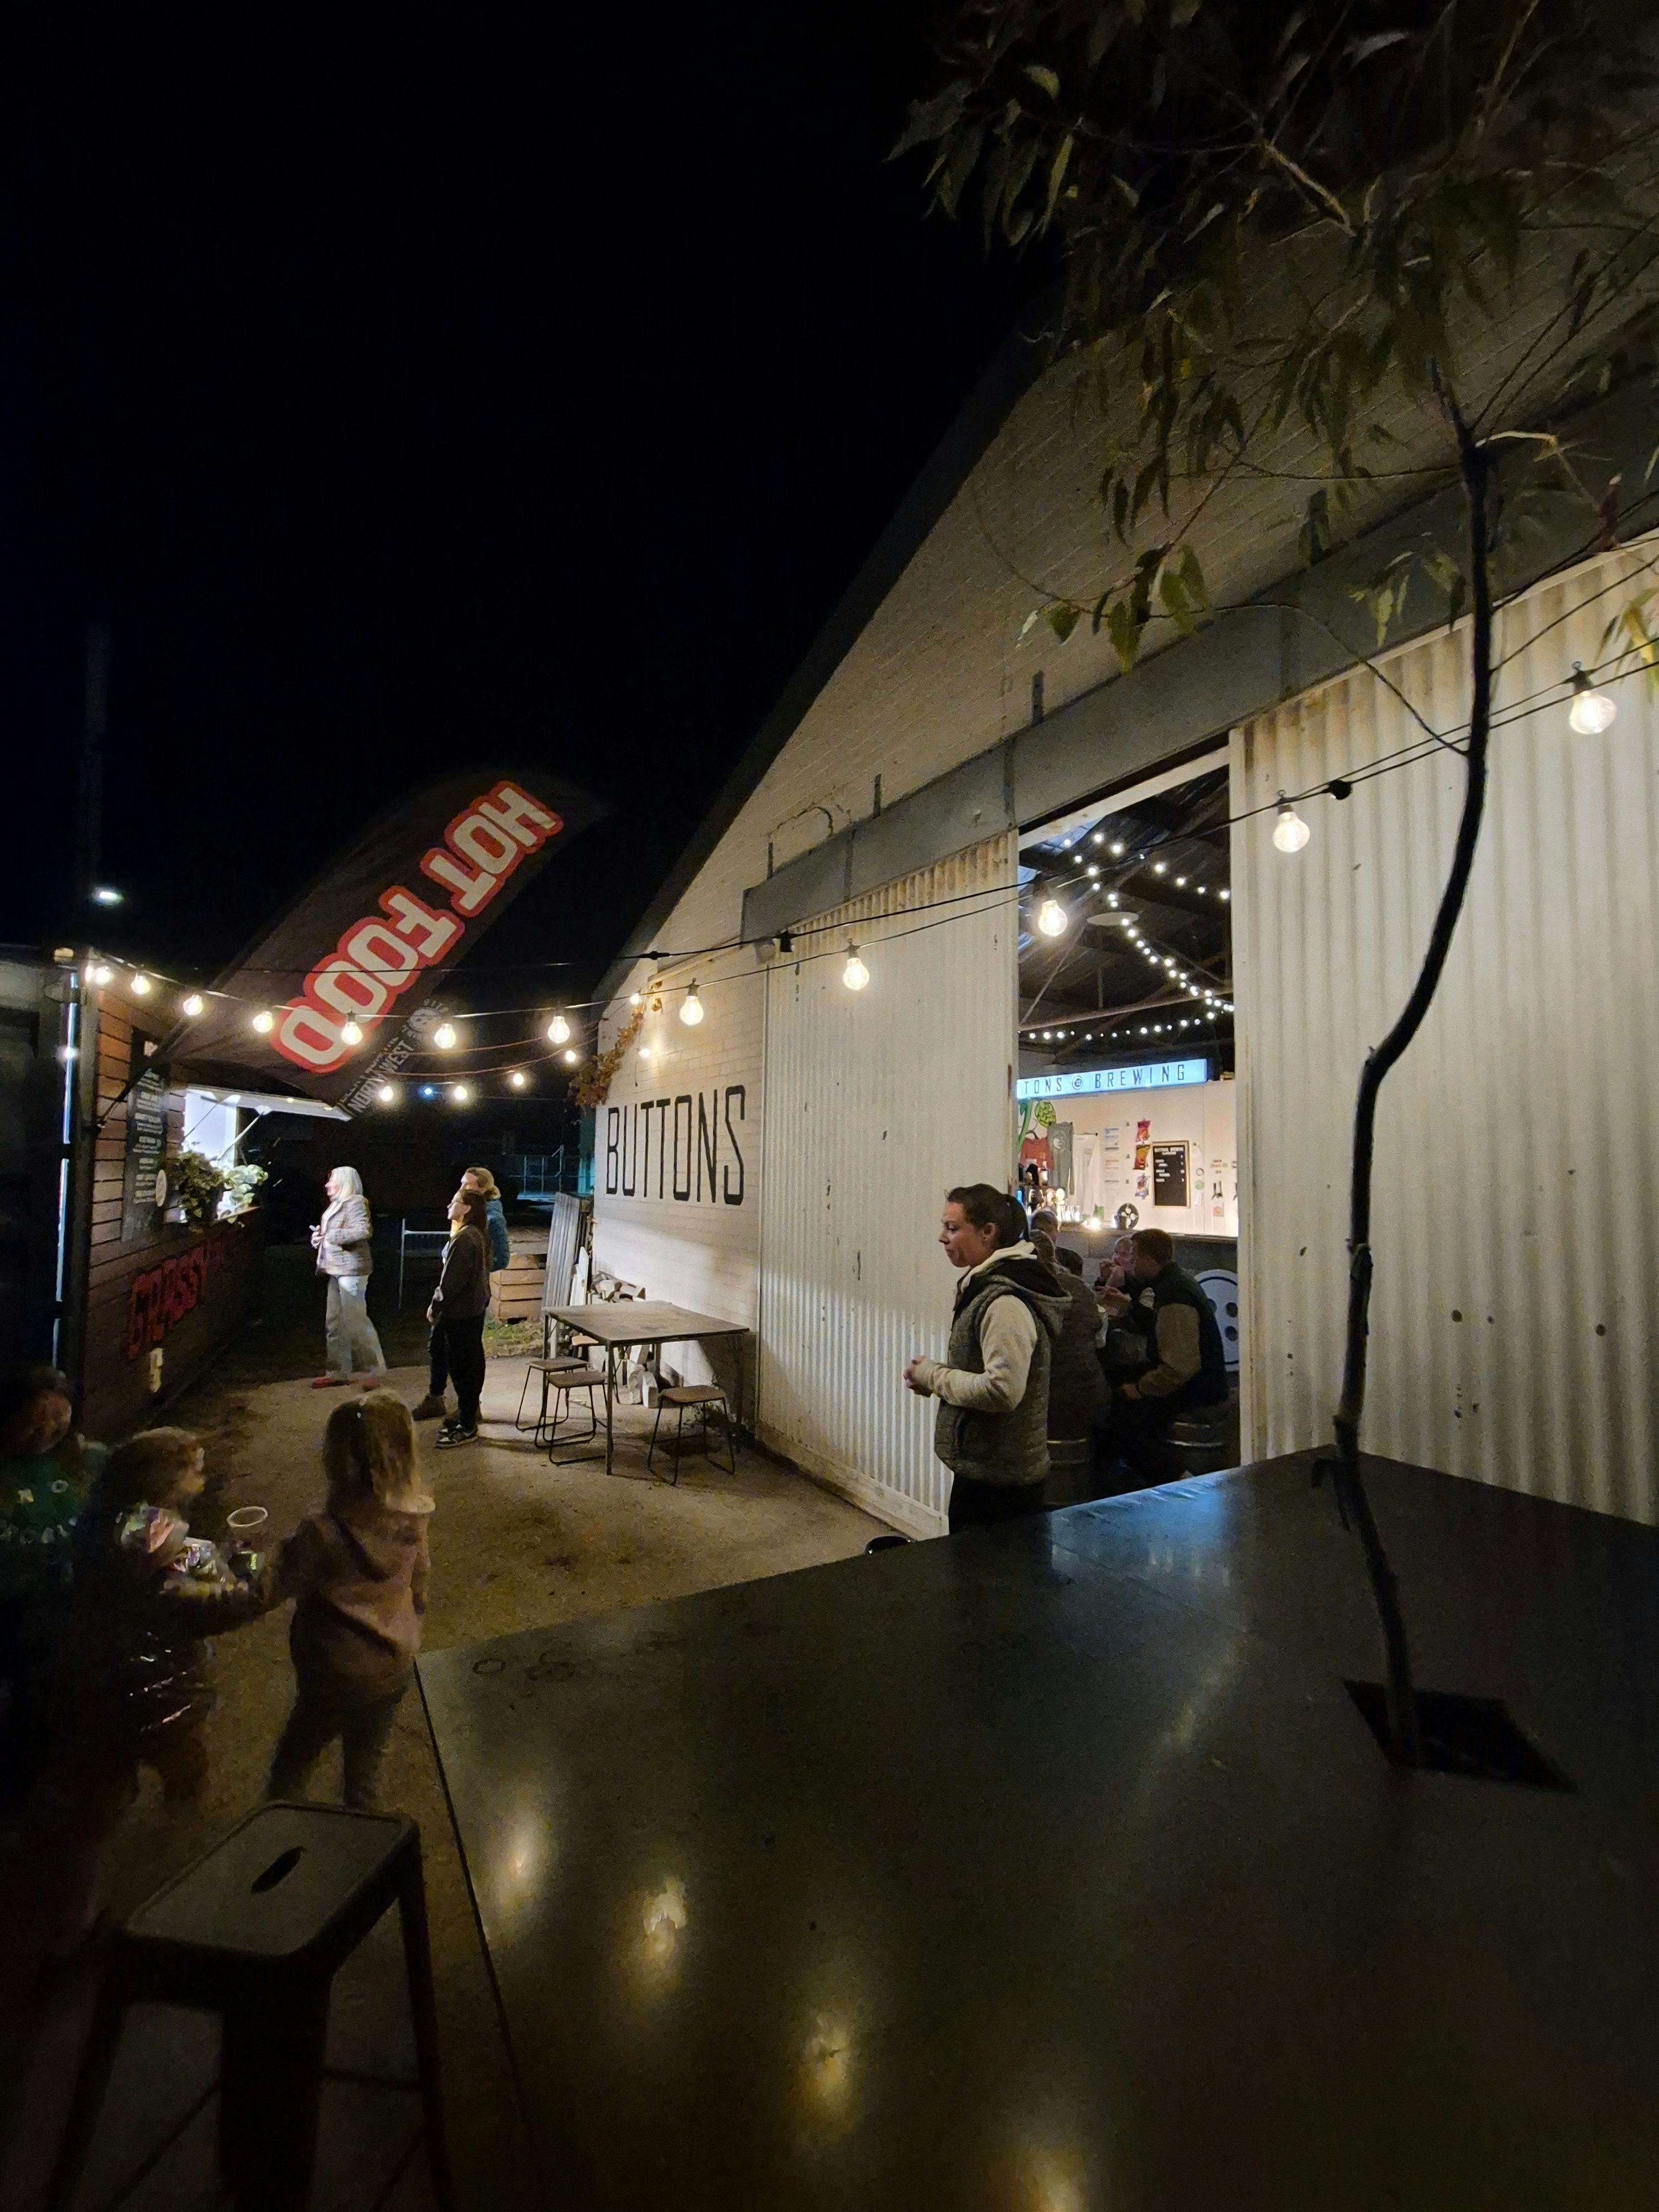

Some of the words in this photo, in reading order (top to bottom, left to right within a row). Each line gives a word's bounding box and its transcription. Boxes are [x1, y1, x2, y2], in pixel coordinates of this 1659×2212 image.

[426, 785, 559, 912] HOT
[278, 891, 459, 1066] FOOD
[378, 1039, 415, 1075] WEST
[1094, 1064, 1186, 1089] BREWING
[606, 1084, 747, 1207] BUTTONS
